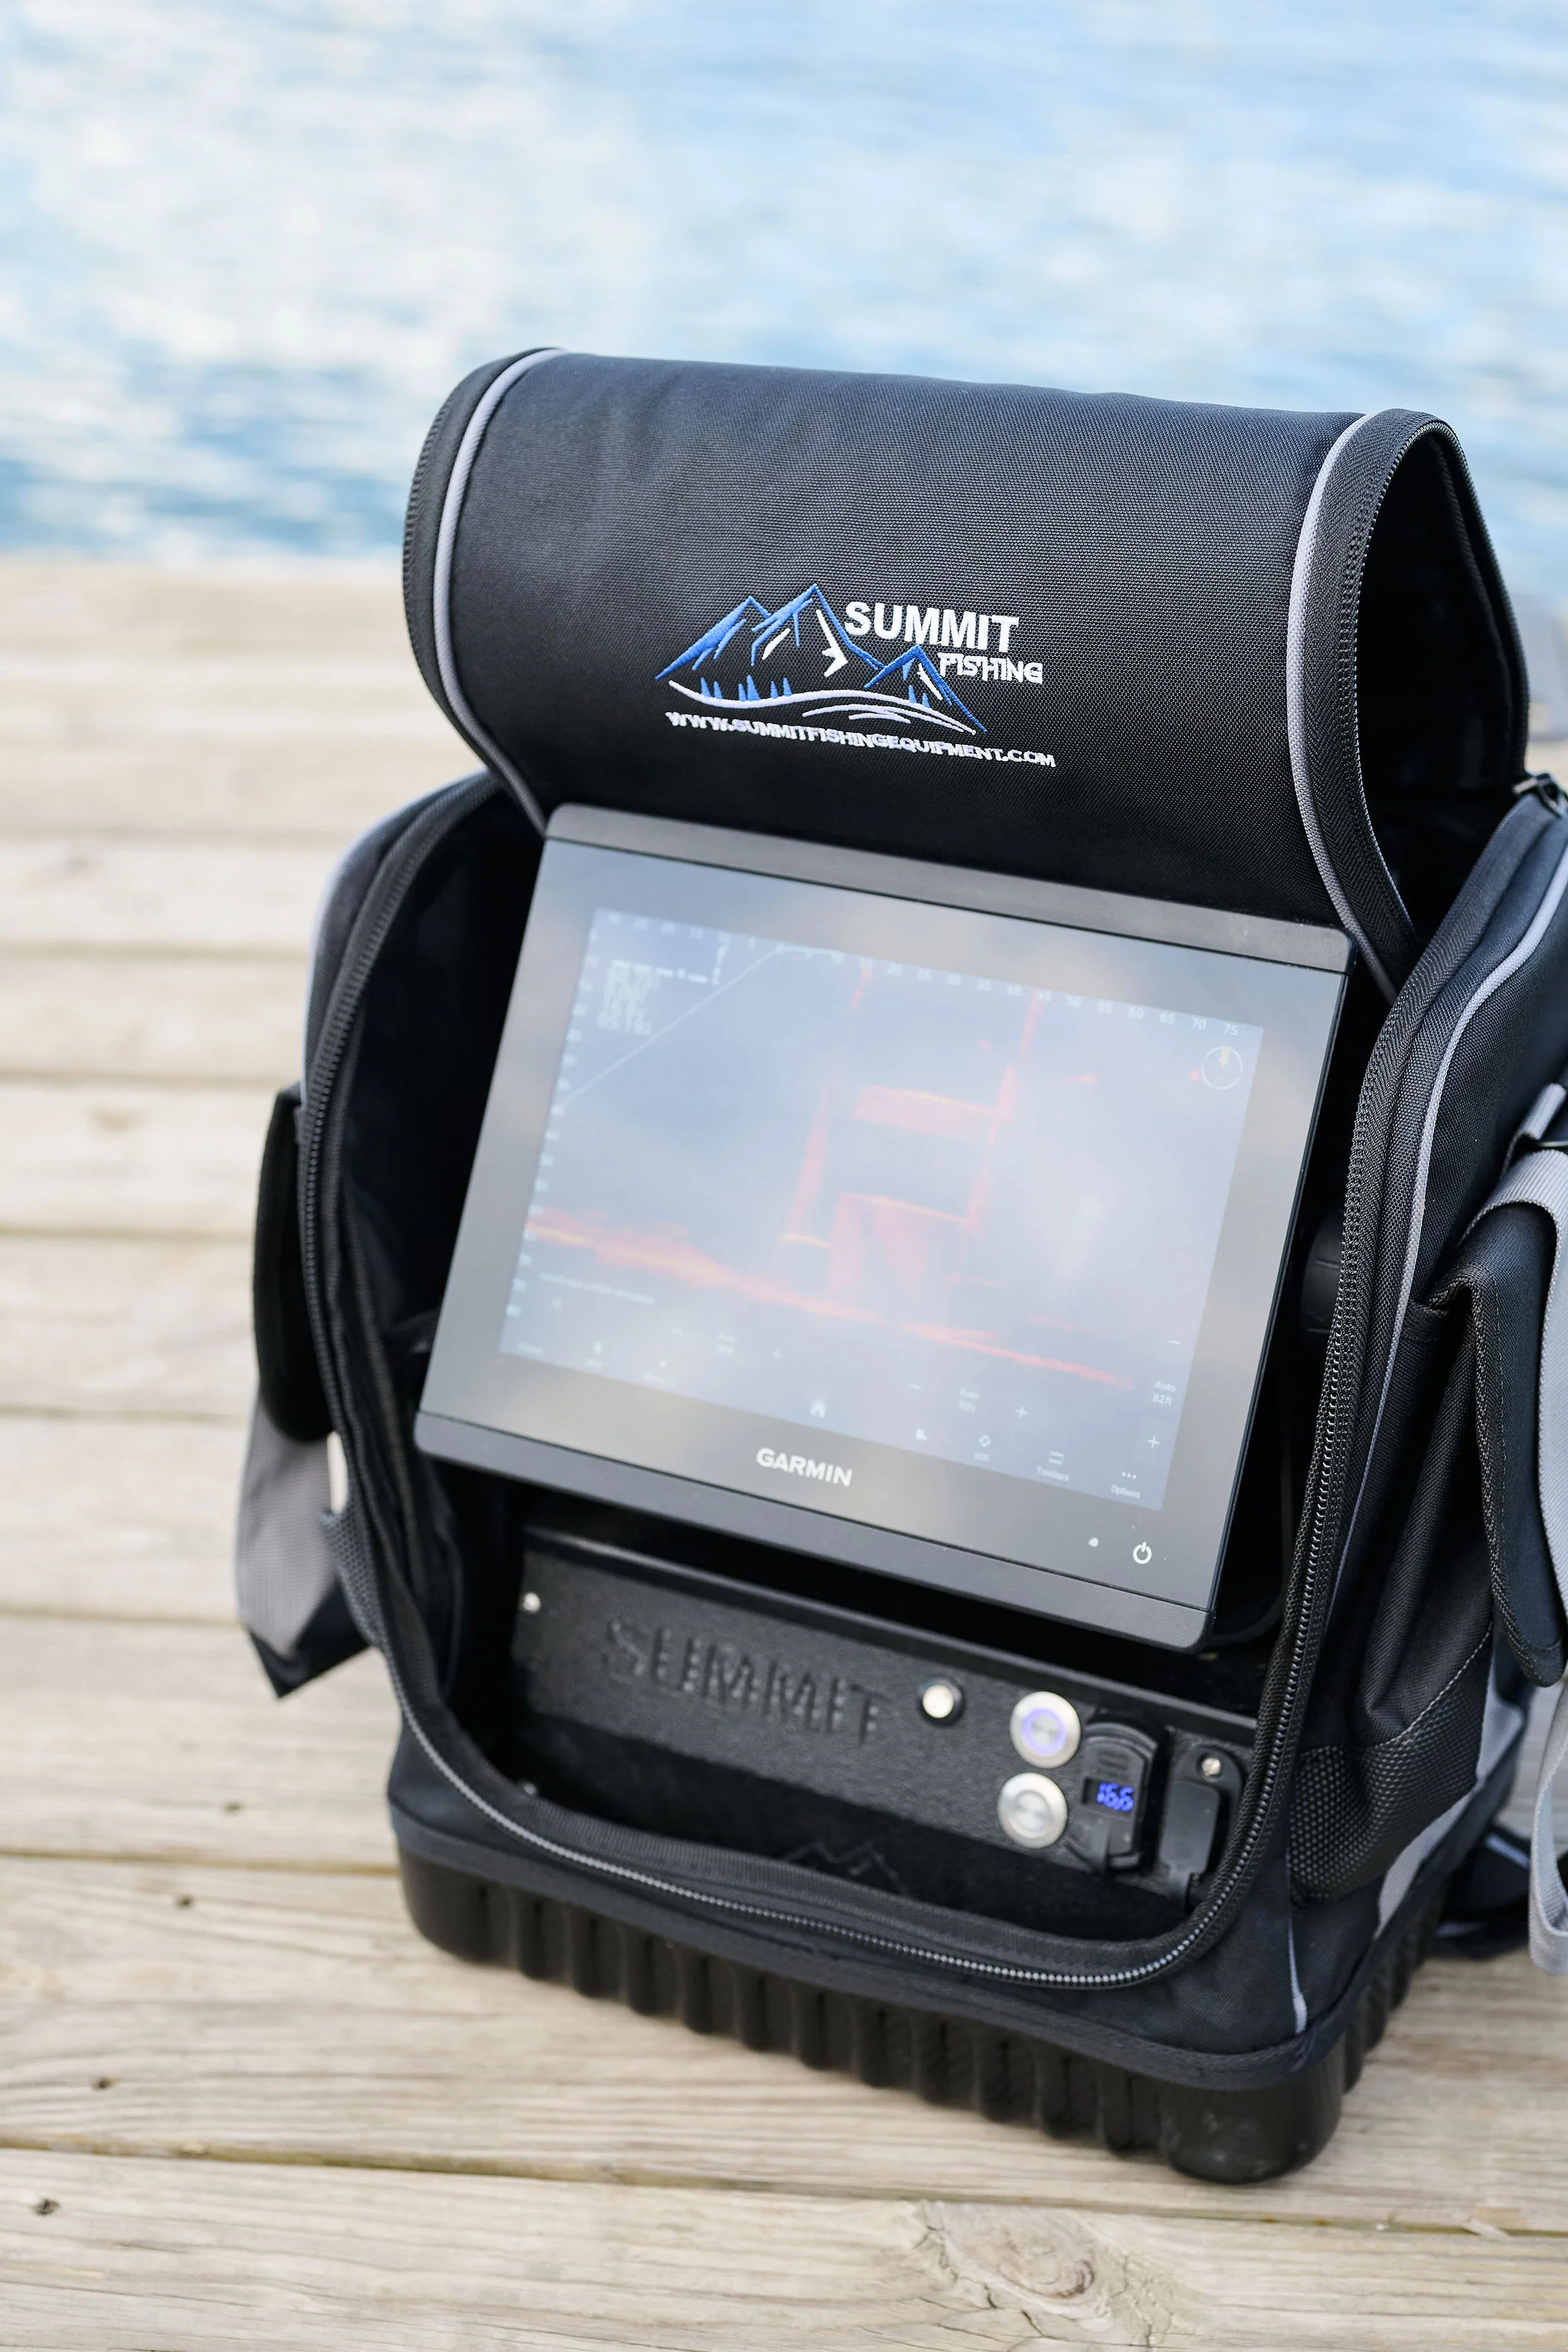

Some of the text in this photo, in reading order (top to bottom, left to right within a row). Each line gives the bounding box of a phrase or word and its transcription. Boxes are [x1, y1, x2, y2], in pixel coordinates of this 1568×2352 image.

[844, 601, 1019, 652] SUMMIT
[938, 652, 1044, 684] FISHING
[1192, 1017, 1207, 1030] 70
[1224, 1023, 1238, 1035] 75
[756, 1447, 853, 1488] GARMIN
[1110, 1484, 1141, 1499] Options
[602, 1618, 892, 1747] SUMMIT
